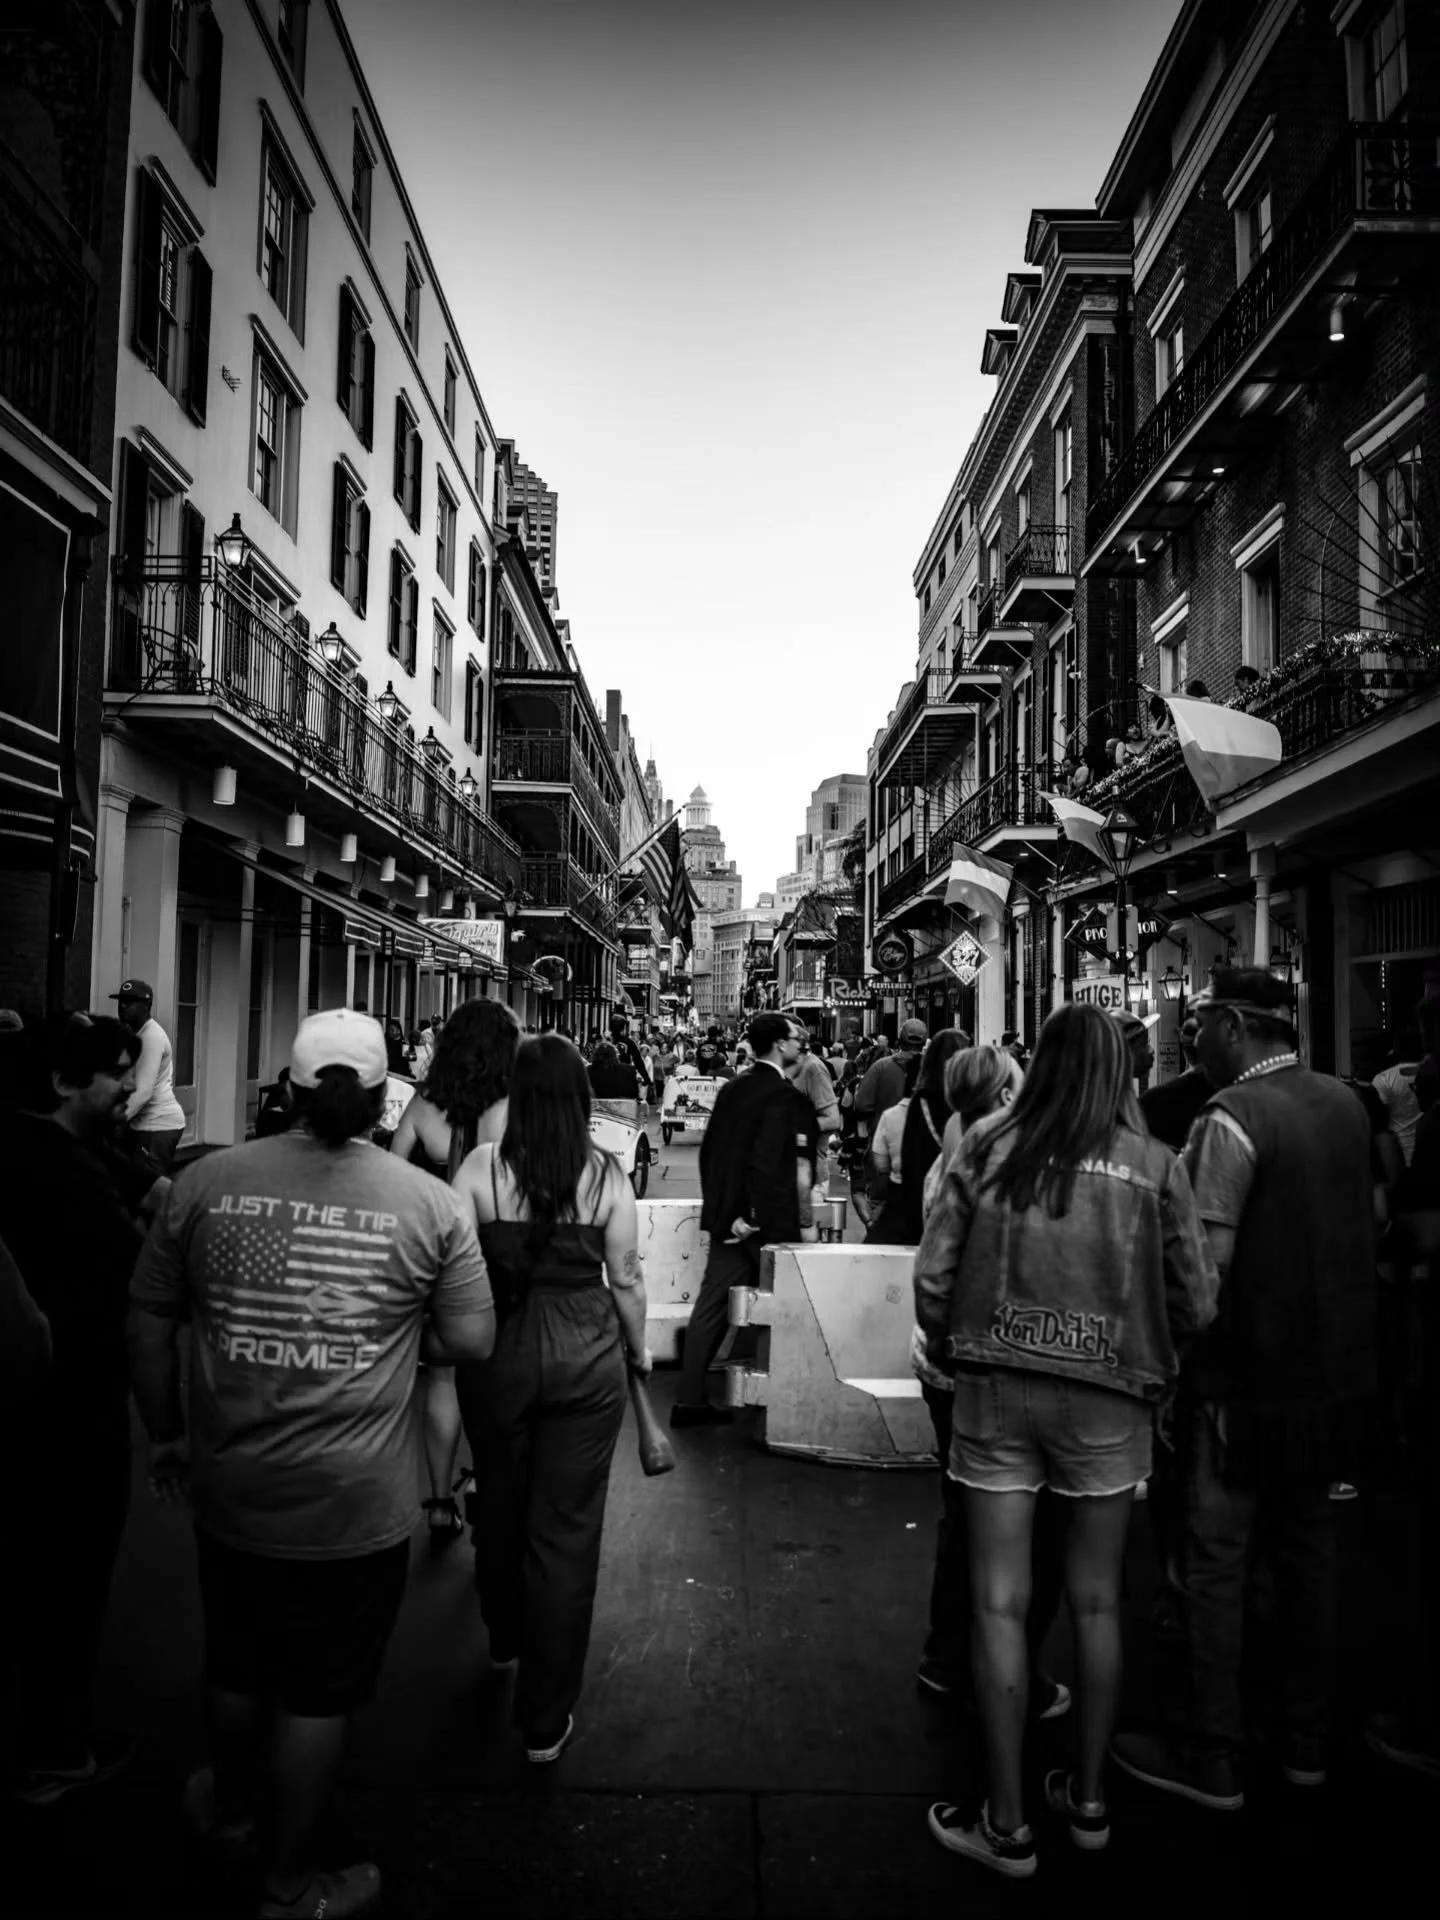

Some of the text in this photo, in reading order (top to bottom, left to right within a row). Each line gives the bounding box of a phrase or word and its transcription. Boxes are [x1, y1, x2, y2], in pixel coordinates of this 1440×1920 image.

[952, 949, 979, 967] 327
[828, 978, 872, 999] Rick's
[1075, 984, 1123, 1009] HUGE
[209, 1195, 398, 1232] JUST THE TIP
[995, 1304, 1112, 1361] Von Dutch
[218, 1332, 382, 1371] PROMISE
